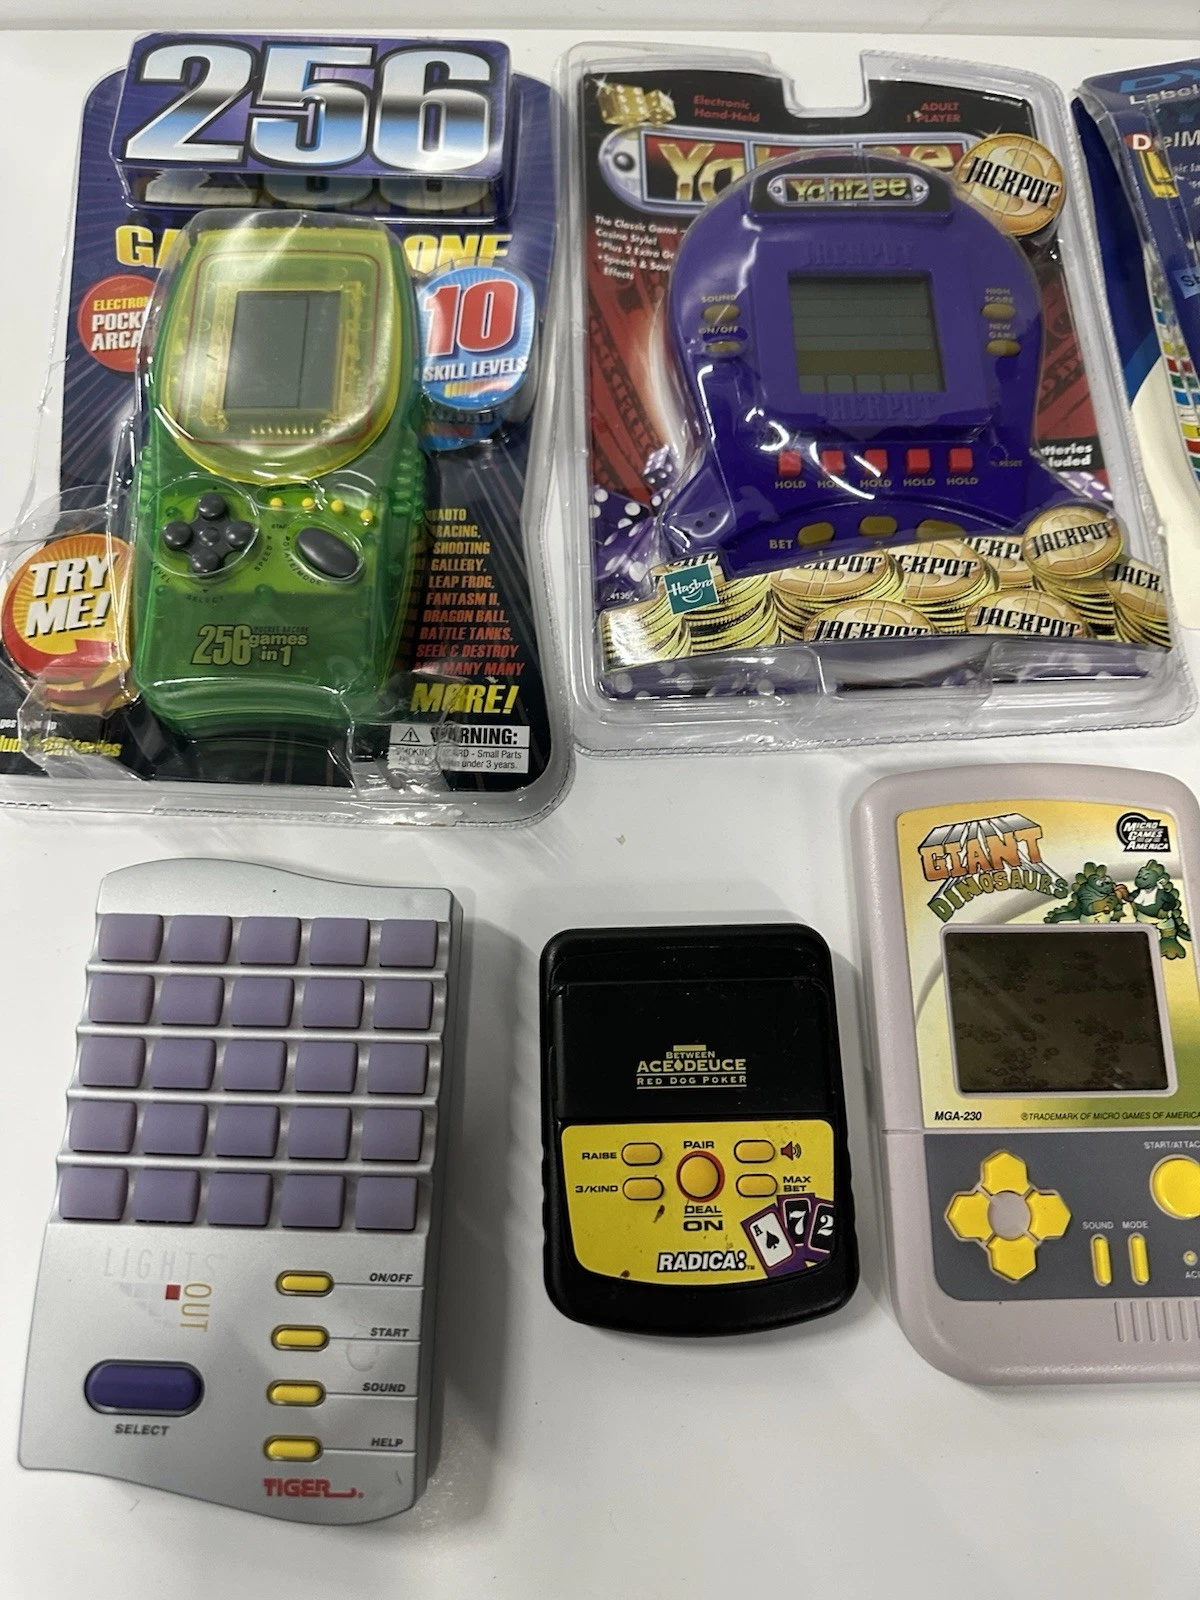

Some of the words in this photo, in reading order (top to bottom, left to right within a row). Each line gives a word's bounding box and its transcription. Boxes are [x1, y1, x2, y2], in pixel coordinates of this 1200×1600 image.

[125, 43, 492, 171] 256
[694, 95, 750, 109] Electronic
[921, 102, 960, 112] ADULT
[694, 108, 761, 123] Hand-Held
[917, 113, 961, 123] PLAYER
[963, 157, 1060, 207] JACKPOT
[791, 178, 908, 201] Yahtzee
[595, 215, 612, 226] The
[614, 219, 646, 232] Classic
[648, 224, 678, 235] Game
[595, 228, 628, 241] Casino
[625, 245, 632, 255] 2
[634, 247, 660, 258] Extra
[603, 254, 637, 267] Speech
[650, 262, 672, 271] Sou
[603, 266, 635, 280] Effects
[93, 296, 149, 311] ELECTRO
[701, 294, 737, 303] SOUND
[92, 312, 146, 332] POCK
[424, 279, 518, 357] 10
[698, 325, 738, 335] ON/OFF
[91, 331, 141, 351] ARCA
[423, 361, 467, 381] SKILL
[472, 357, 527, 378] LEVELS
[1040, 443, 1093, 456] tteries
[1048, 455, 1091, 467] luded
[774, 481, 806, 490] HOLD
[859, 478, 892, 488] HOLD
[903, 477, 935, 487] HOLD
[946, 476, 979, 486] HOLD
[438, 509, 467, 521] AUTO
[769, 540, 793, 550] BET
[1030, 522, 1115, 559] JACKPOT
[433, 541, 490, 554] SHOOTING
[897, 555, 977, 578] CKPOT
[30, 553, 118, 597] TRY
[428, 575, 459, 588] LEAP
[1111, 563, 1163, 593] JACK
[668, 579, 714, 596] Hasbro
[426, 592, 486, 606] FANTASM
[24, 591, 113, 638] ME!
[423, 610, 474, 623] DRAGON
[973, 606, 1081, 637] JACKPOT
[420, 627, 466, 640] BATTLE
[190, 624, 252, 666] 256
[248, 634, 308, 648] games
[260, 646, 278, 661] in
[280, 645, 292, 666] 1
[416, 644, 449, 658] SEEK
[461, 644, 519, 658] DESTROY
[443, 662, 482, 676] MANY
[484, 662, 525, 676] MANY
[410, 683, 519, 714] MORE!
[477, 750, 499, 759] Small
[501, 750, 522, 759] Parts
[461, 760, 484, 768] under
[486, 760, 491, 768] 3
[494, 761, 517, 770] years.
[1123, 822, 1159, 832] MICRO
[1128, 830, 1163, 840] GAMES
[919, 822, 1043, 882] GIANT
[1126, 841, 1169, 850] AMERICA
[927, 869, 1069, 923] DINOSAURS
[665, 1051, 716, 1060] BETWEEN
[636, 1077, 663, 1086] RED
[670, 1076, 697, 1085] DOG
[702, 1075, 747, 1084] POKER
[934, 1111, 982, 1121] MGA-230
[1080, 1112, 1092, 1120] OF
[1093, 1112, 1121, 1120] MICRO
[1122, 1112, 1151, 1120] GAMES
[1152, 1111, 1164, 1119] OF
[683, 1140, 715, 1150] PAIR
[1143, 1141, 1200, 1150] START/ATTAC
[581, 1152, 617, 1160] RAISE
[575, 1185, 618, 1193] 3/KIND
[783, 1184, 806, 1192] BET
[684, 1205, 722, 1214] DEAL
[683, 1220, 723, 1231] ON
[788, 1210, 807, 1235] 7
[817, 1214, 834, 1236] 2
[1083, 1221, 1114, 1230] SOUND
[1122, 1220, 1149, 1229] MODE
[752, 1224, 762, 1237] A
[103, 1247, 218, 1281] LIGHTS
[369, 1273, 413, 1283] ON/OFF
[180, 1282, 212, 1332] OUT
[370, 1327, 409, 1338] START
[362, 1382, 406, 1393] SOUND
[114, 1424, 170, 1436] SELECT
[371, 1438, 403, 1448] HELP
[263, 1478, 356, 1498] TIGER
